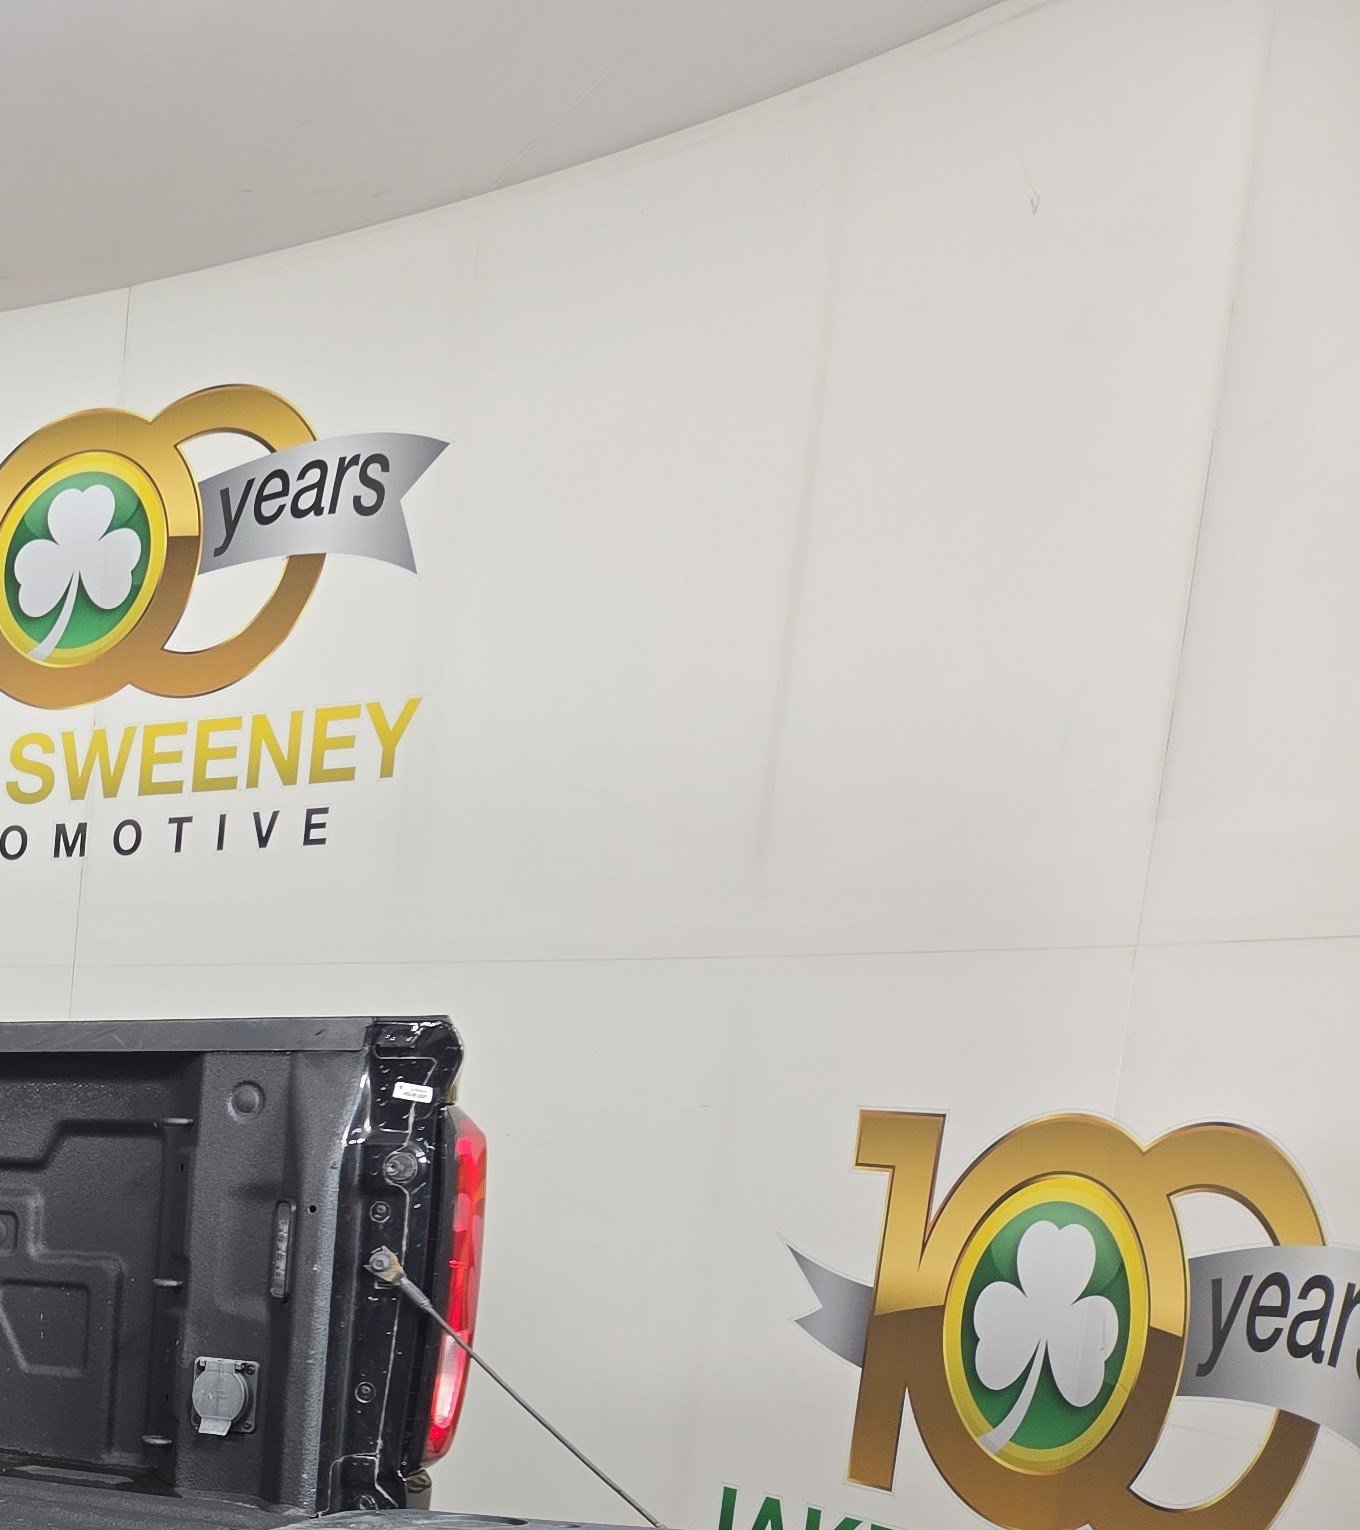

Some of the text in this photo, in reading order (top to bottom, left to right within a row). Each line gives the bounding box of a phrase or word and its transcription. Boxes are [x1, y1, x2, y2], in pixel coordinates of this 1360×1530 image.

[213, 450, 390, 557] years
[5, 697, 423, 805] SWEENEY
[1195, 1270, 1360, 1380] year
